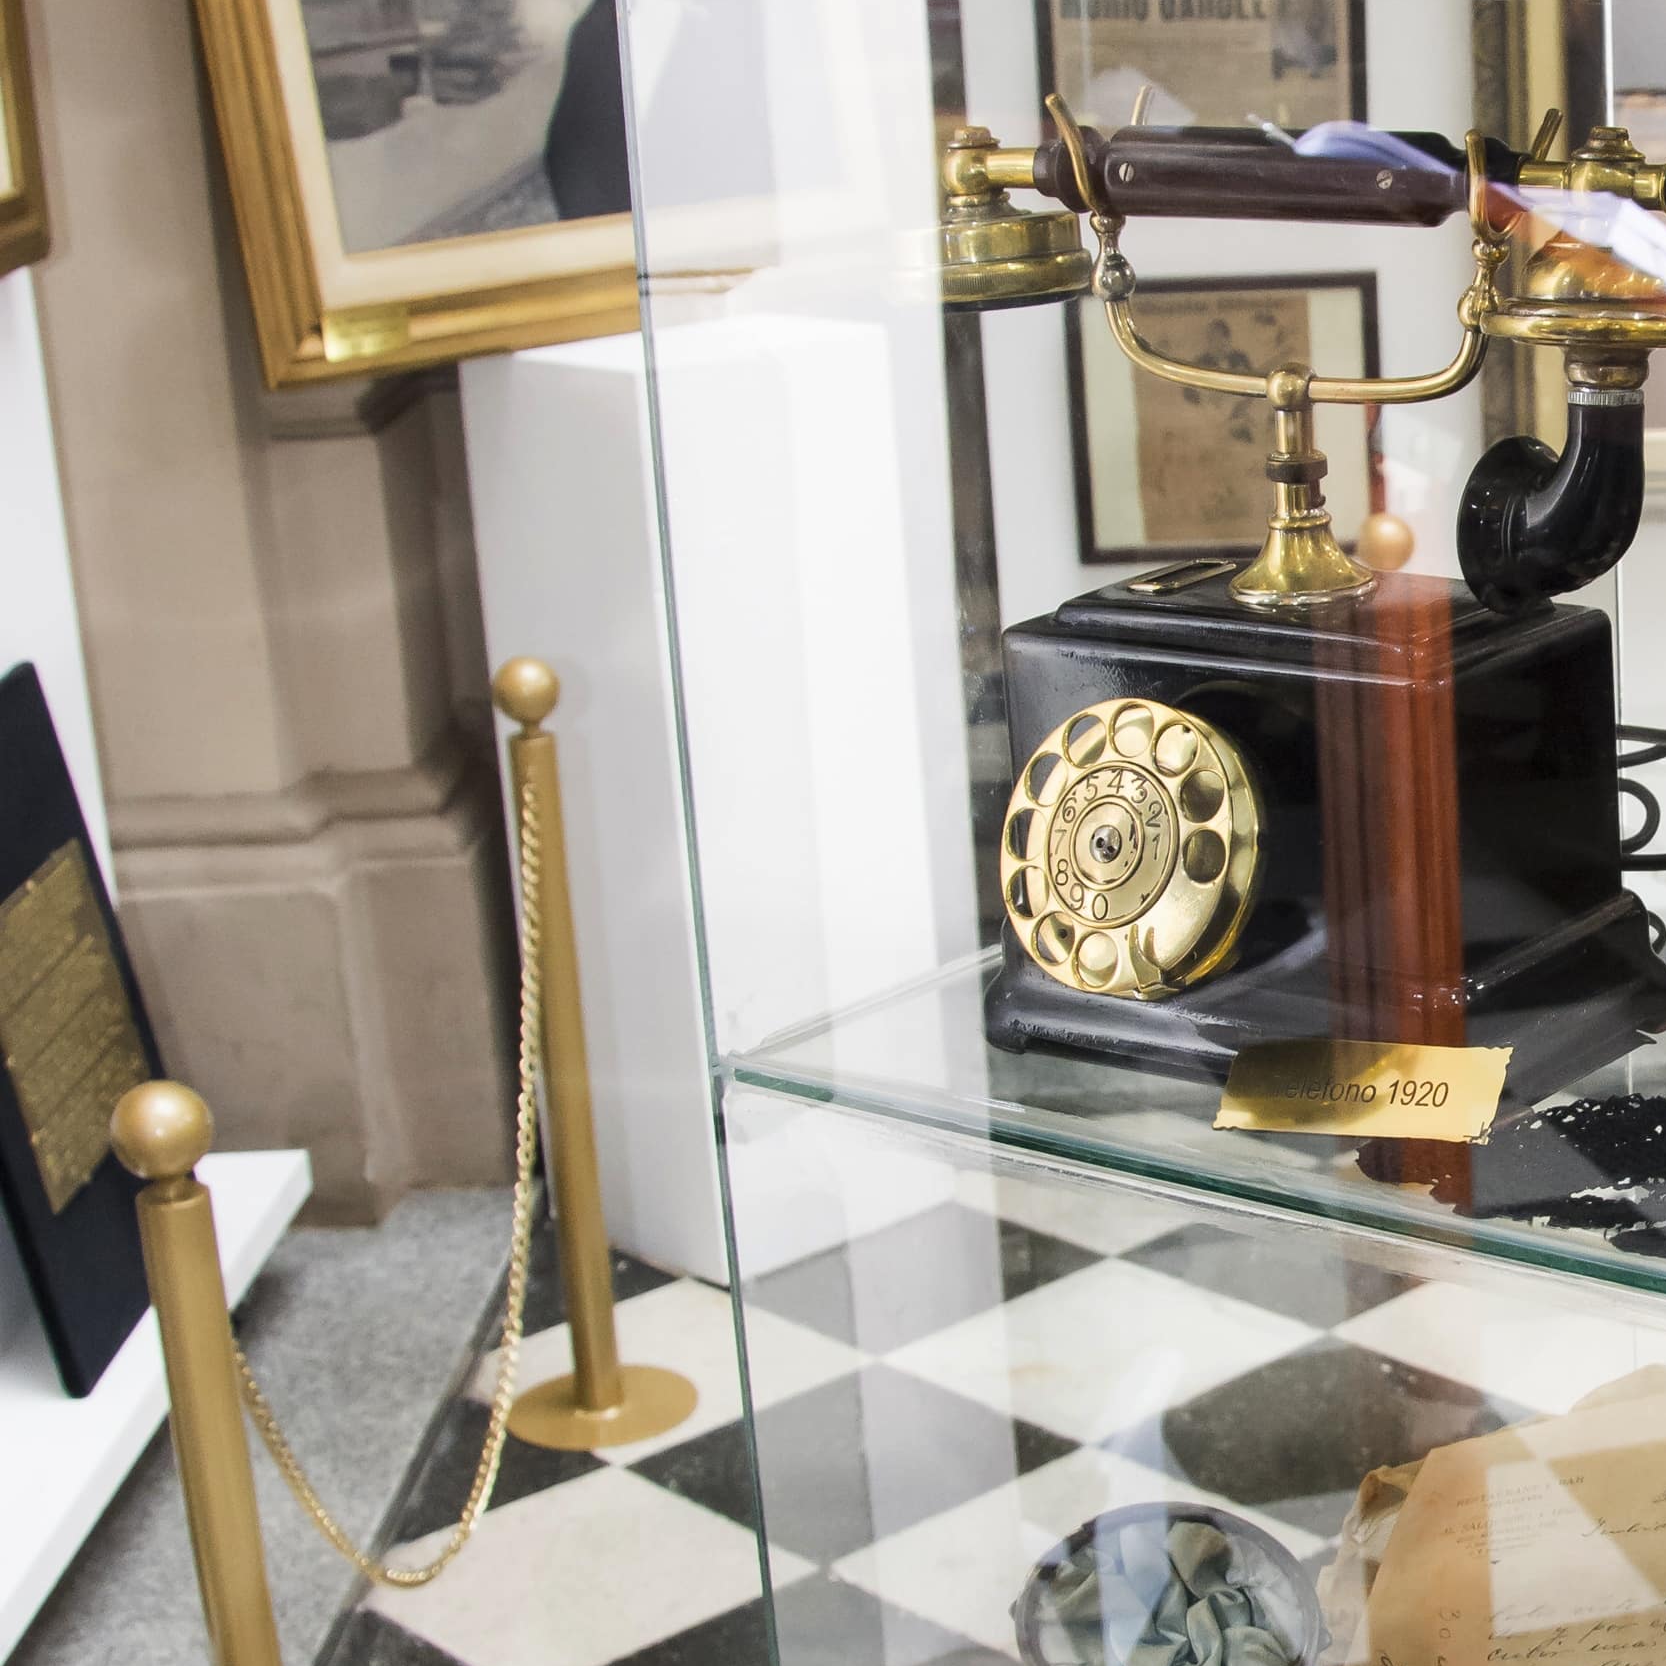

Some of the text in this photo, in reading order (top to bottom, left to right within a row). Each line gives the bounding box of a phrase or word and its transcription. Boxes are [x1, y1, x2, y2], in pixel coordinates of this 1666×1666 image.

[1084, 774, 1099, 801] 5
[1107, 771, 1125, 796] 4
[1130, 778, 1148, 804] 3
[1062, 795, 1078, 825] 6
[1145, 802, 1163, 828] 2
[1053, 829, 1067, 856] 7
[1151, 833, 1161, 861] 1
[1055, 858, 1069, 888] 8
[1069, 883, 1085, 911] 9
[1091, 893, 1109, 921] 0
[1386, 1079, 1449, 1108] 1920
